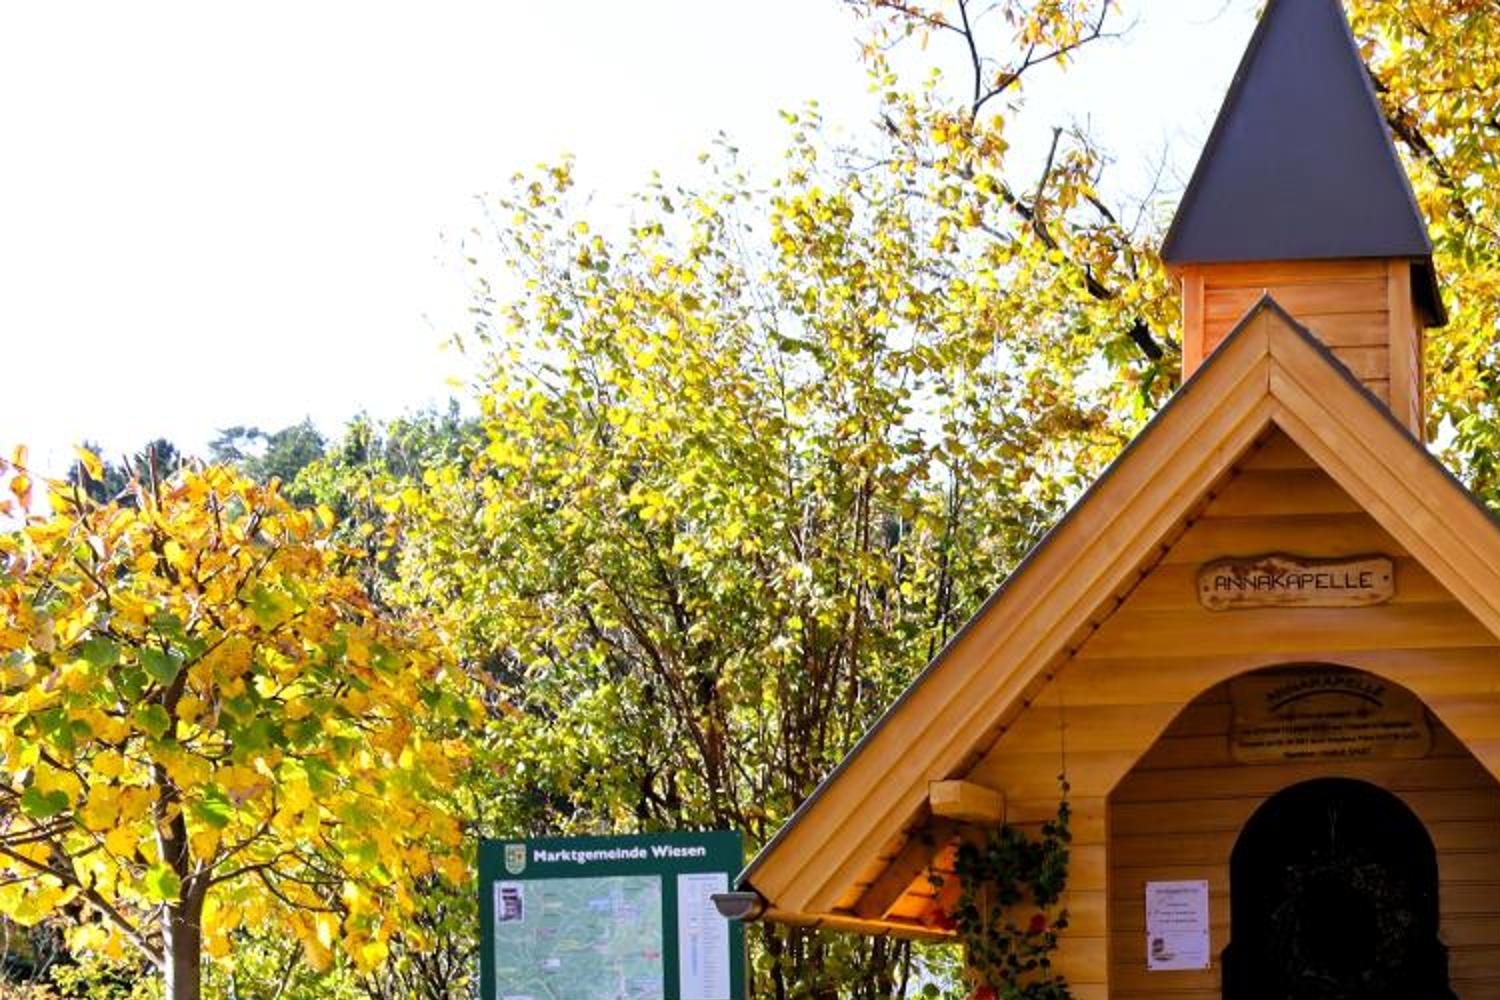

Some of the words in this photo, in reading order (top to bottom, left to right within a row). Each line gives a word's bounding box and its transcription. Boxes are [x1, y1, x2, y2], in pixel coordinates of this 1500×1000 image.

[1215, 571, 1374, 591] ANNAKAPELLE
[533, 846, 647, 864] Marktgemeinde
[650, 845, 706, 859] Wiesen
